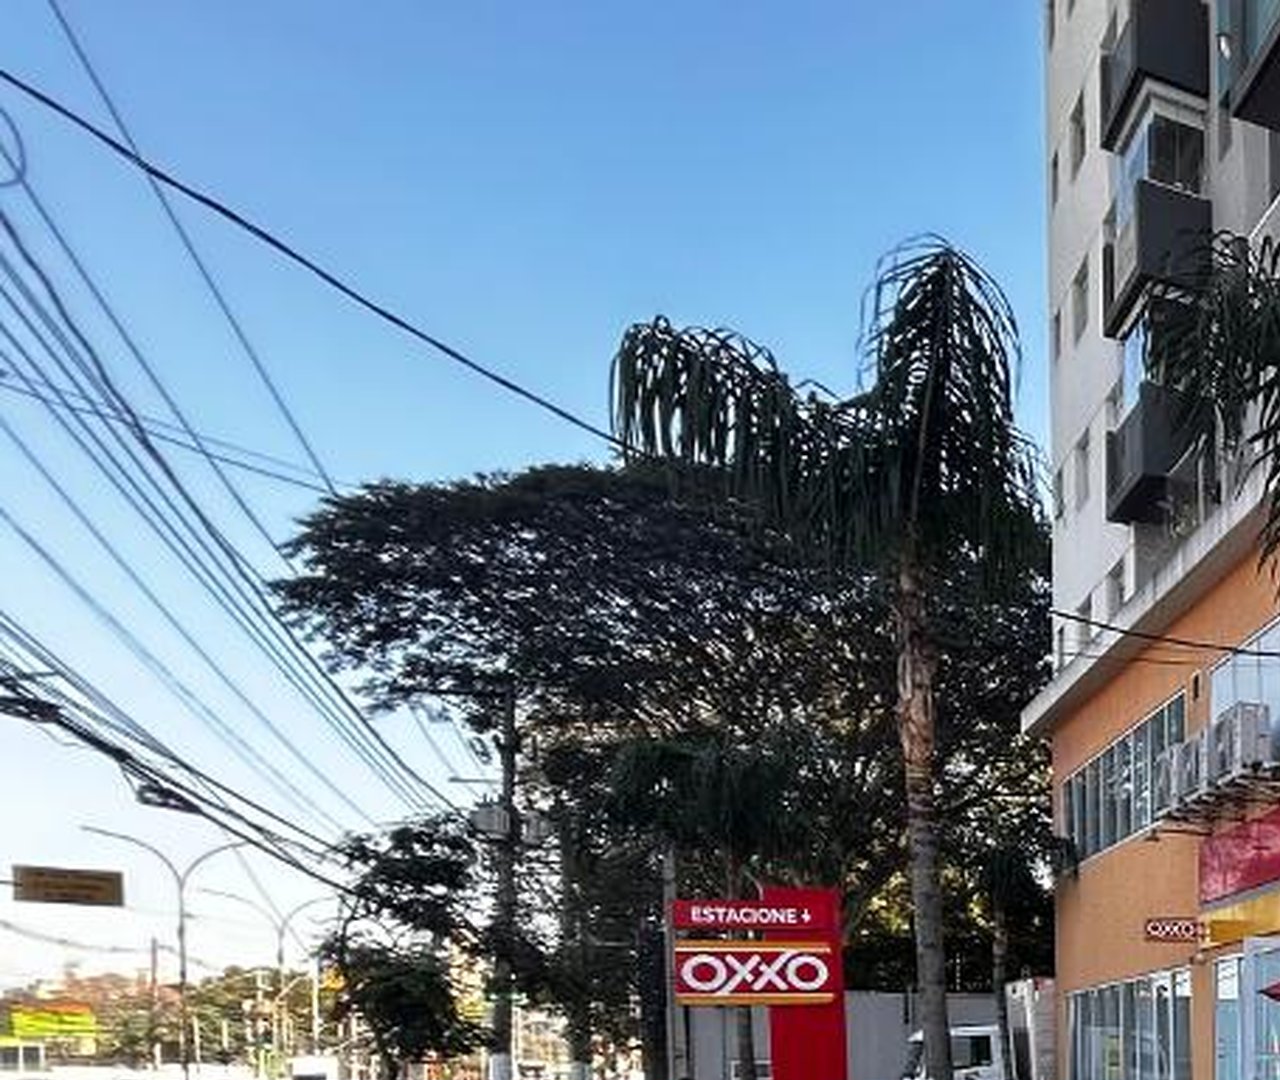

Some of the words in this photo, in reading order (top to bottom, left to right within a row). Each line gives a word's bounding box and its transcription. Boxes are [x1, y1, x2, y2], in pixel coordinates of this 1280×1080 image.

[690, 907, 797, 924] ESTACIONE
[1147, 921, 1195, 939] OXXO
[681, 951, 829, 996] OXXO
